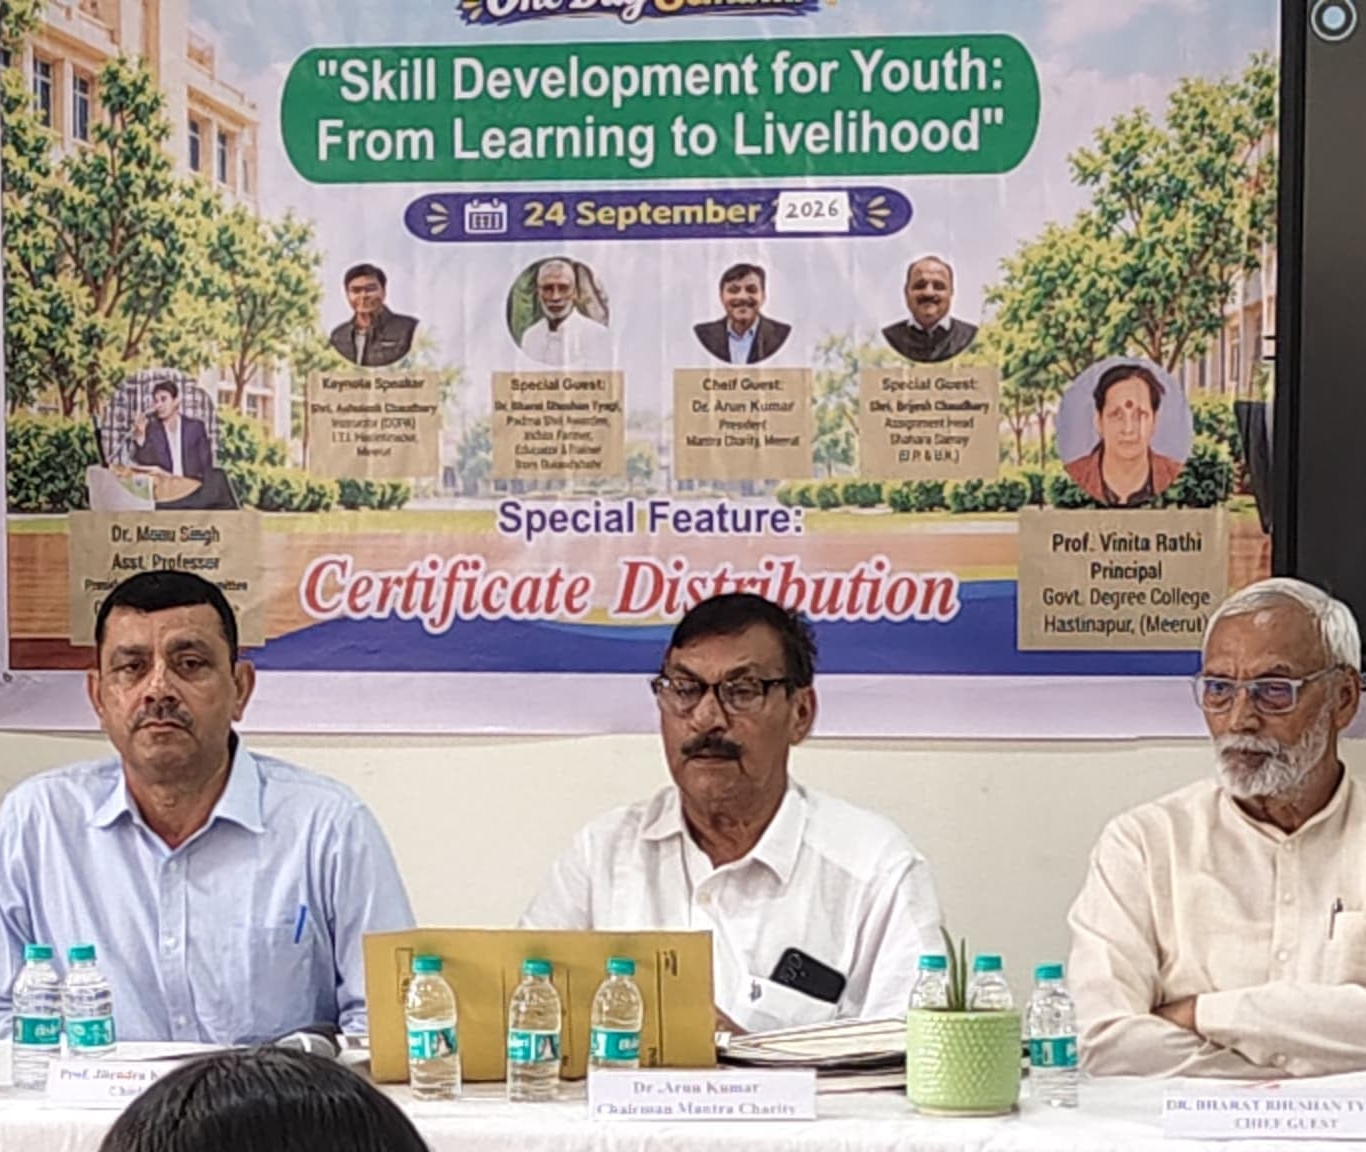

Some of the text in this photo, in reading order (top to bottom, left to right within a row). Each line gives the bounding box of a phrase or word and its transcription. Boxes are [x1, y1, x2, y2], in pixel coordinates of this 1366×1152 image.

[318, 47, 1003, 108] "Skill Development for Youth:
[318, 107, 1004, 168] From Learning to Livelihood"
[523, 198, 762, 231] 24 September
[784, 200, 840, 219] 2026
[322, 377, 425, 392] Keynote Speaker
[510, 378, 560, 393] Special
[882, 378, 931, 392] Special
[714, 400, 747, 412] Arun
[750, 400, 796, 412] Kumar
[499, 500, 803, 541] Special Feature:
[111, 524, 133, 542] Dr.
[179, 524, 220, 546] Singh
[1052, 532, 1203, 552] Prof. Vinita Rathi
[151, 552, 220, 571] Professor
[1090, 561, 1163, 584] Principal
[304, 558, 591, 628] Certificate
[1090, 588, 1146, 609] Degree
[1150, 587, 1211, 610] College
[1044, 615, 1135, 636] Hastinapur,
[706, 1081, 760, 1094] Kumar
[596, 1102, 797, 1116] Chairman Mantra Charity
[1196, 1100, 1261, 1112] BHARAT
